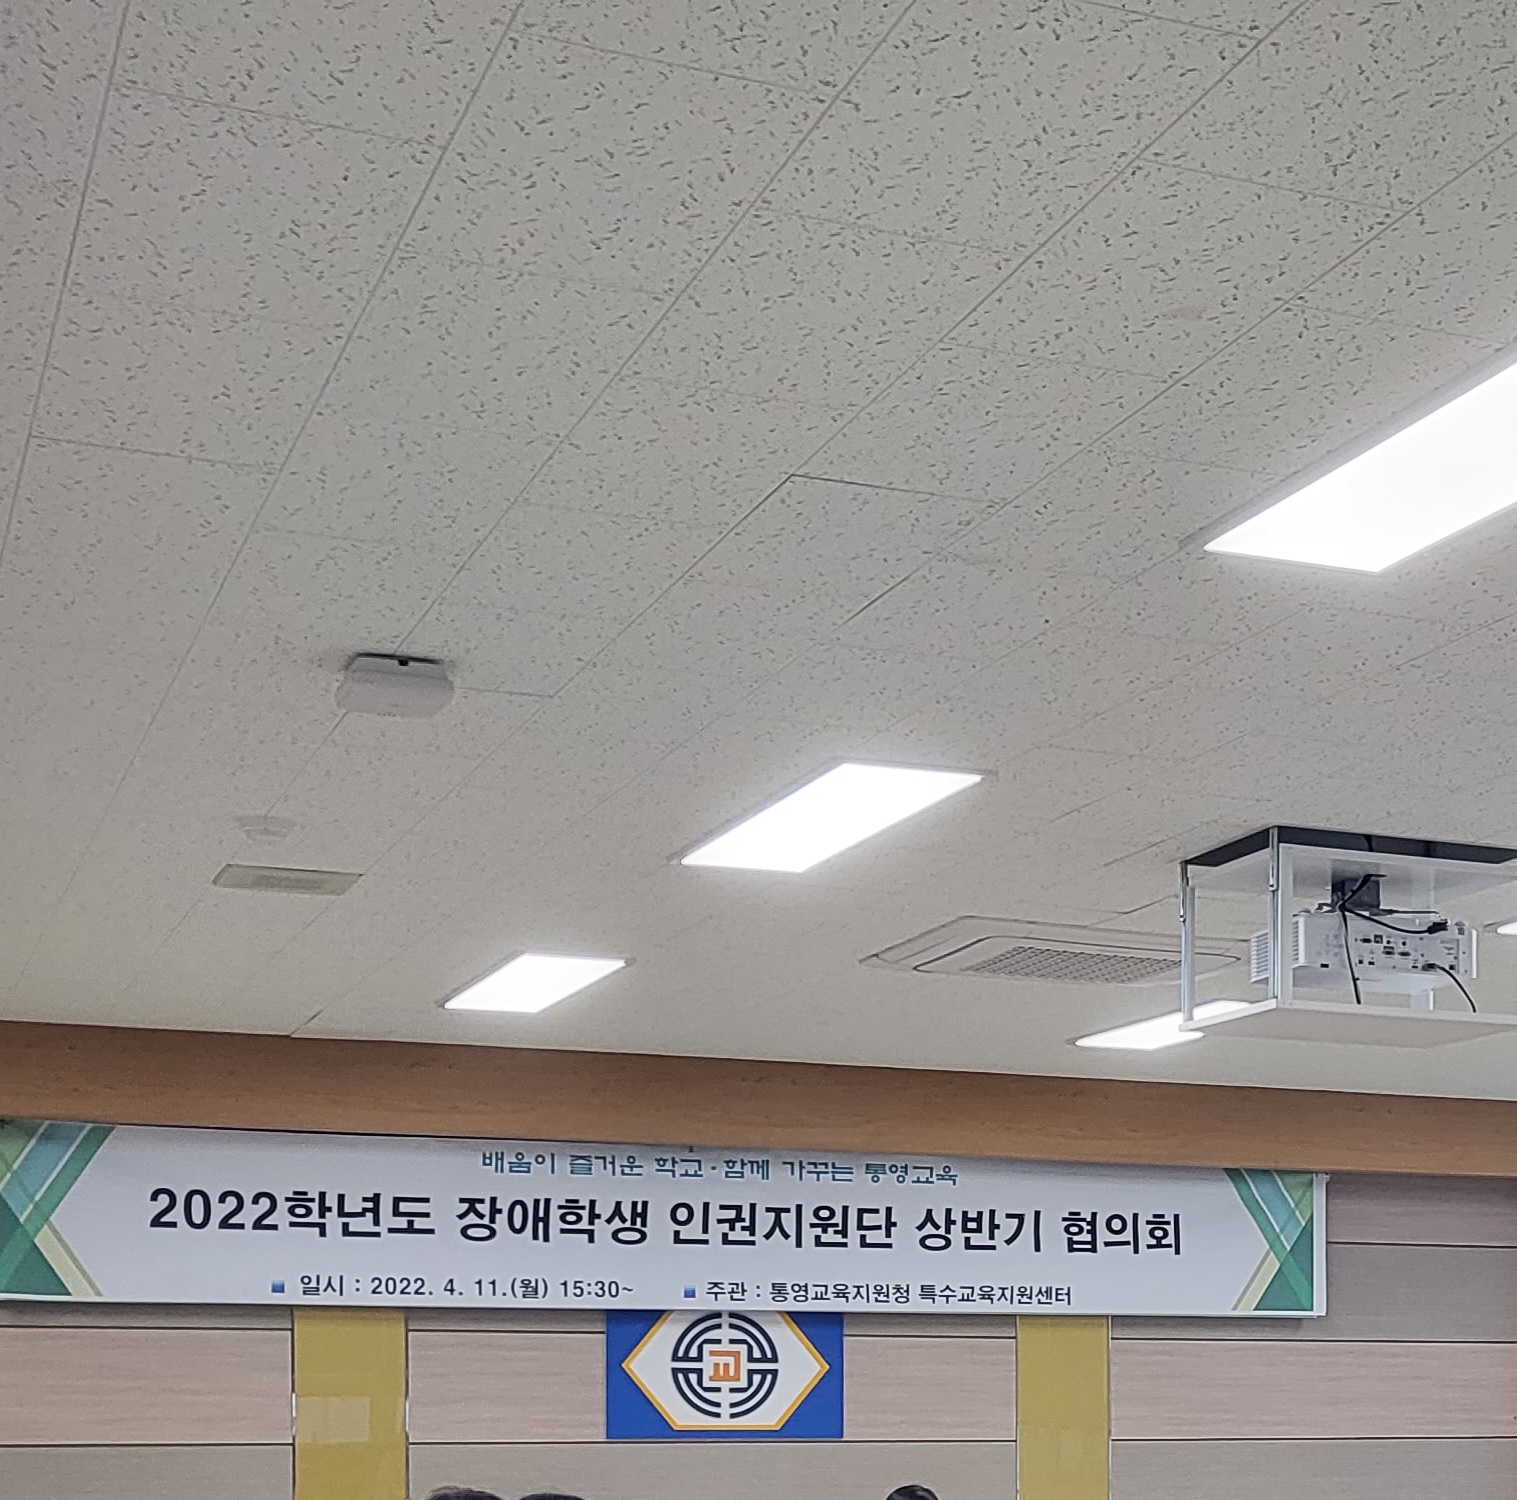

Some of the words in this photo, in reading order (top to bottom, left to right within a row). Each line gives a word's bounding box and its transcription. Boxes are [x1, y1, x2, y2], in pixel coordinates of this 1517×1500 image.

[481, 1151, 555, 1175] 배움이
[569, 1154, 645, 1177] 즐거운
[782, 1160, 855, 1183] 가꾸는
[864, 1162, 959, 1187] 통영교육
[149, 1187, 436, 1238] 2022학년도
[455, 1196, 649, 1246] 장애학생
[669, 1201, 897, 1250] 인권지원단
[915, 1207, 1043, 1254] 상반기
[1061, 1211, 1182, 1256] 협의회
[300, 1274, 345, 1297] 일시
[371, 1276, 433, 1296] 2022.
[443, 1278, 463, 1296] 4.
[474, 1277, 549, 1300] 11.(월)
[560, 1279, 634, 1299] 15:30~
[705, 1280, 748, 1302] 주관
[769, 1282, 911, 1304] 통영교육지원청
[918, 1283, 1072, 1306] 특수교육지원센터
